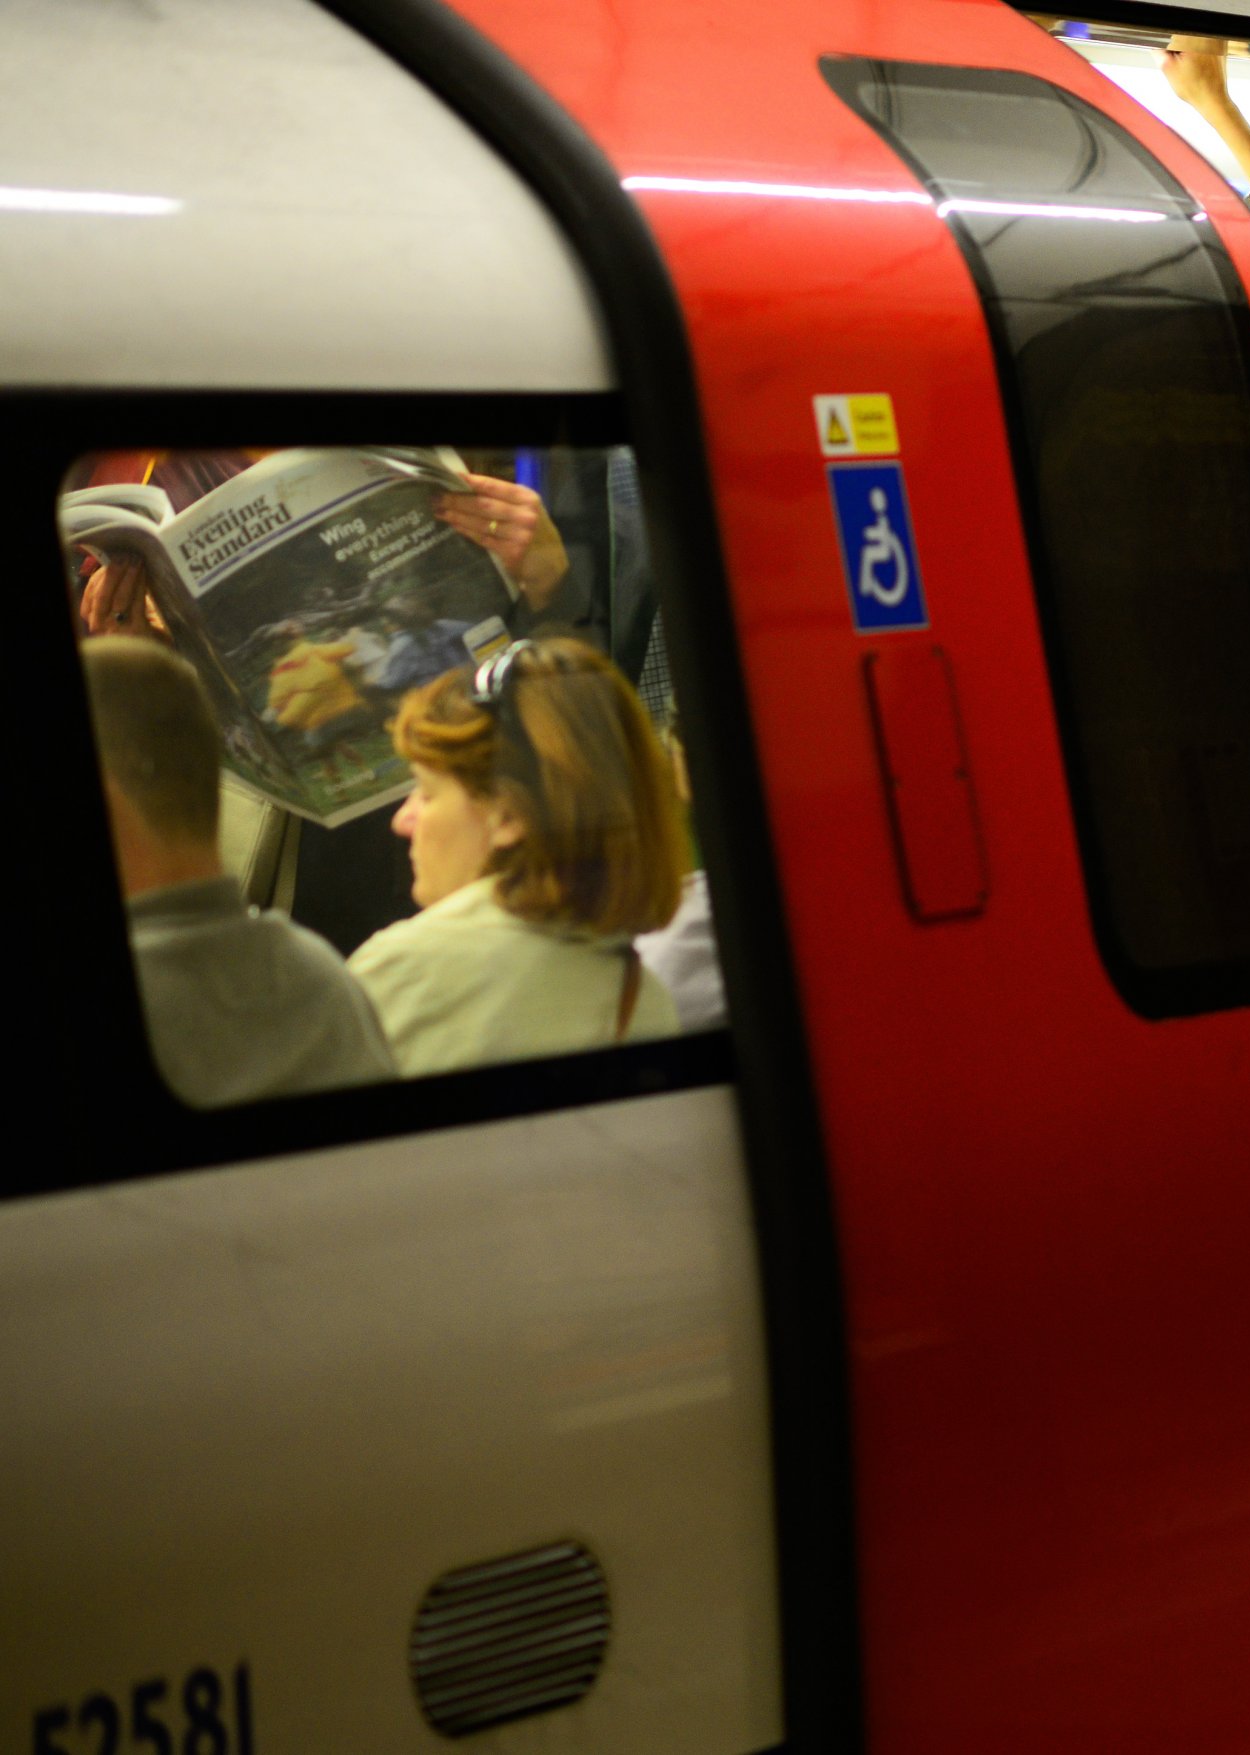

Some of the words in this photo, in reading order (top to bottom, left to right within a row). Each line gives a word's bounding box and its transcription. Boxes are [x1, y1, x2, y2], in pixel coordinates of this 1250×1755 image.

[179, 494, 272, 561] Evening
[189, 502, 292, 580] Standard
[319, 517, 367, 546] Wing
